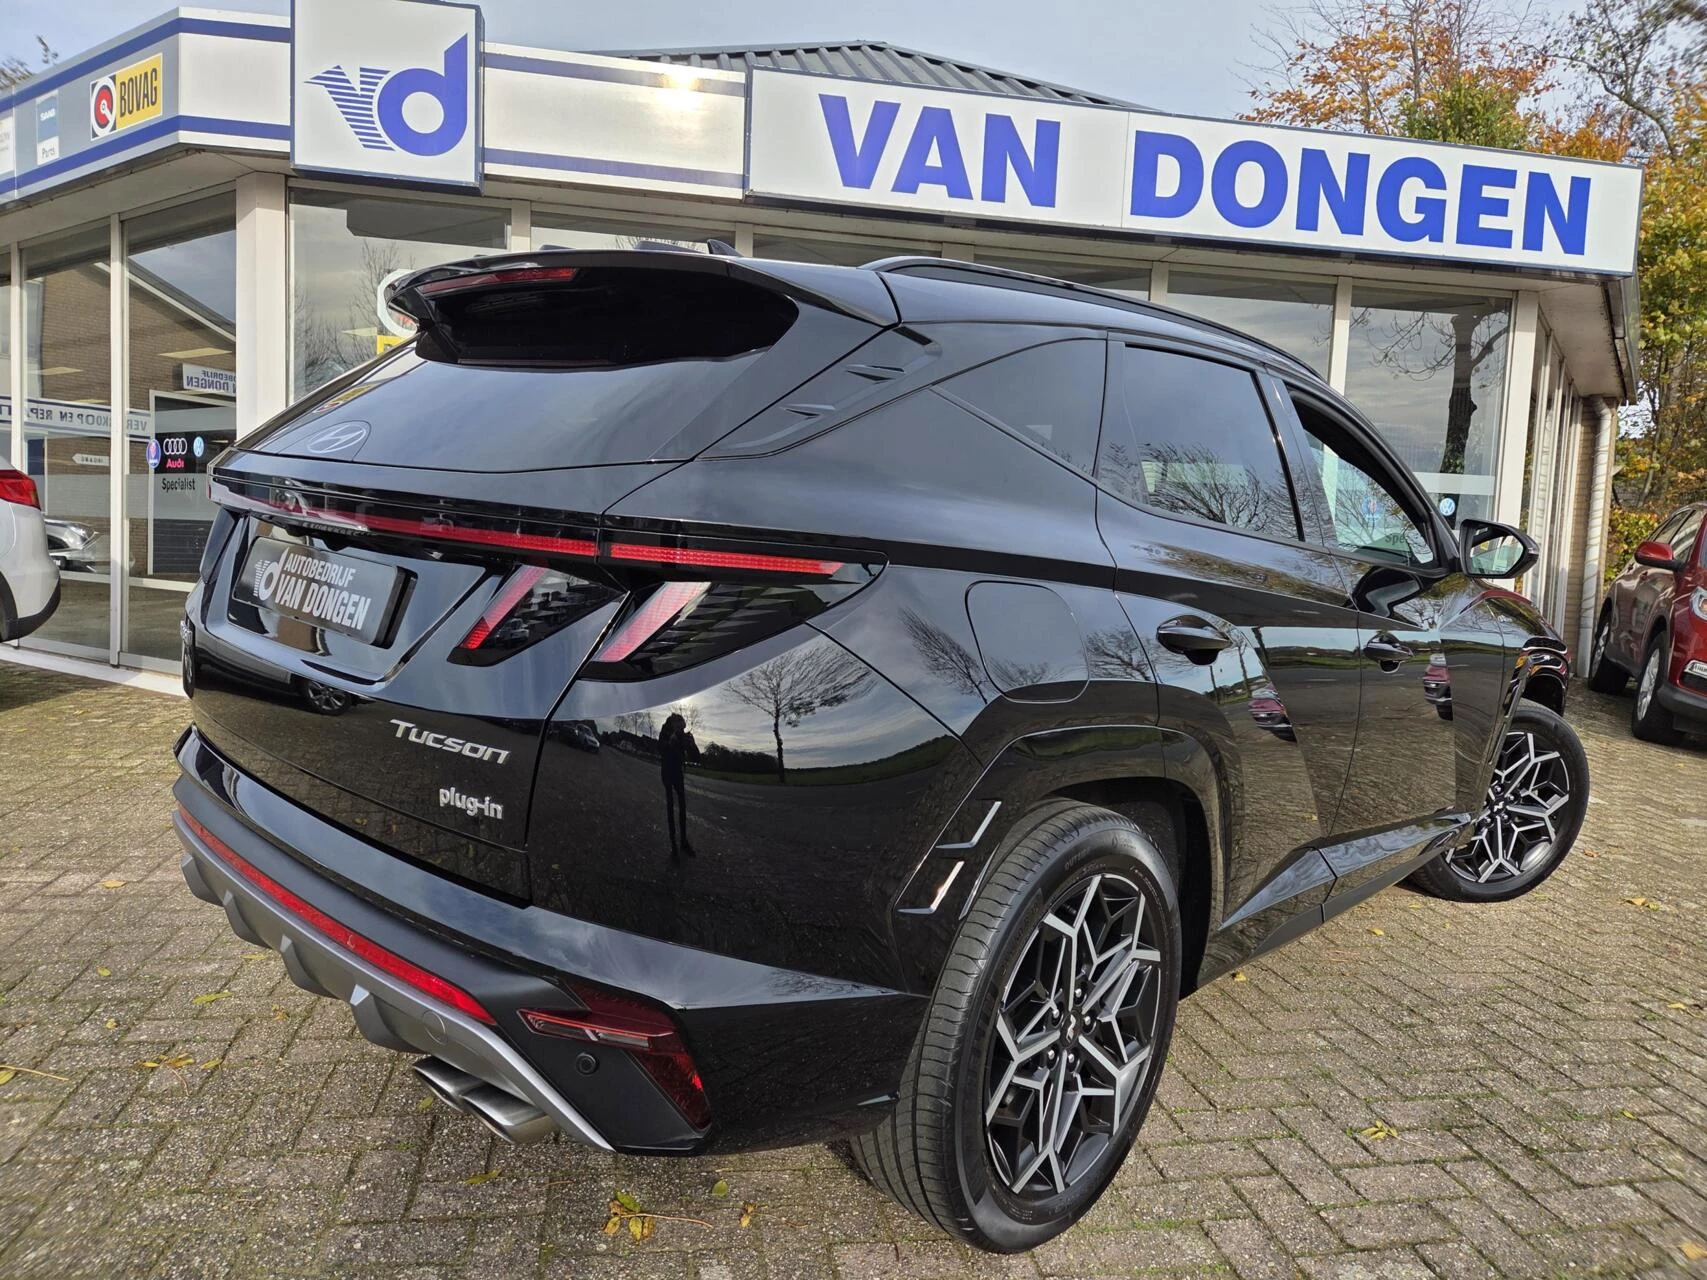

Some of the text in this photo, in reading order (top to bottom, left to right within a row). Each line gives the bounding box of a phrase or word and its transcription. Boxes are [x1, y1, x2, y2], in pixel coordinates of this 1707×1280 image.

[120, 67, 157, 118] BOVAG
[818, 94, 1592, 256] VAN DONGEN
[166, 458, 185, 469] Audi
[161, 477, 196, 493] Specialist
[283, 553, 356, 588] AUTOBEDRIJF
[274, 573, 371, 630] VAN DONGEN
[439, 787, 503, 819] plug-in
